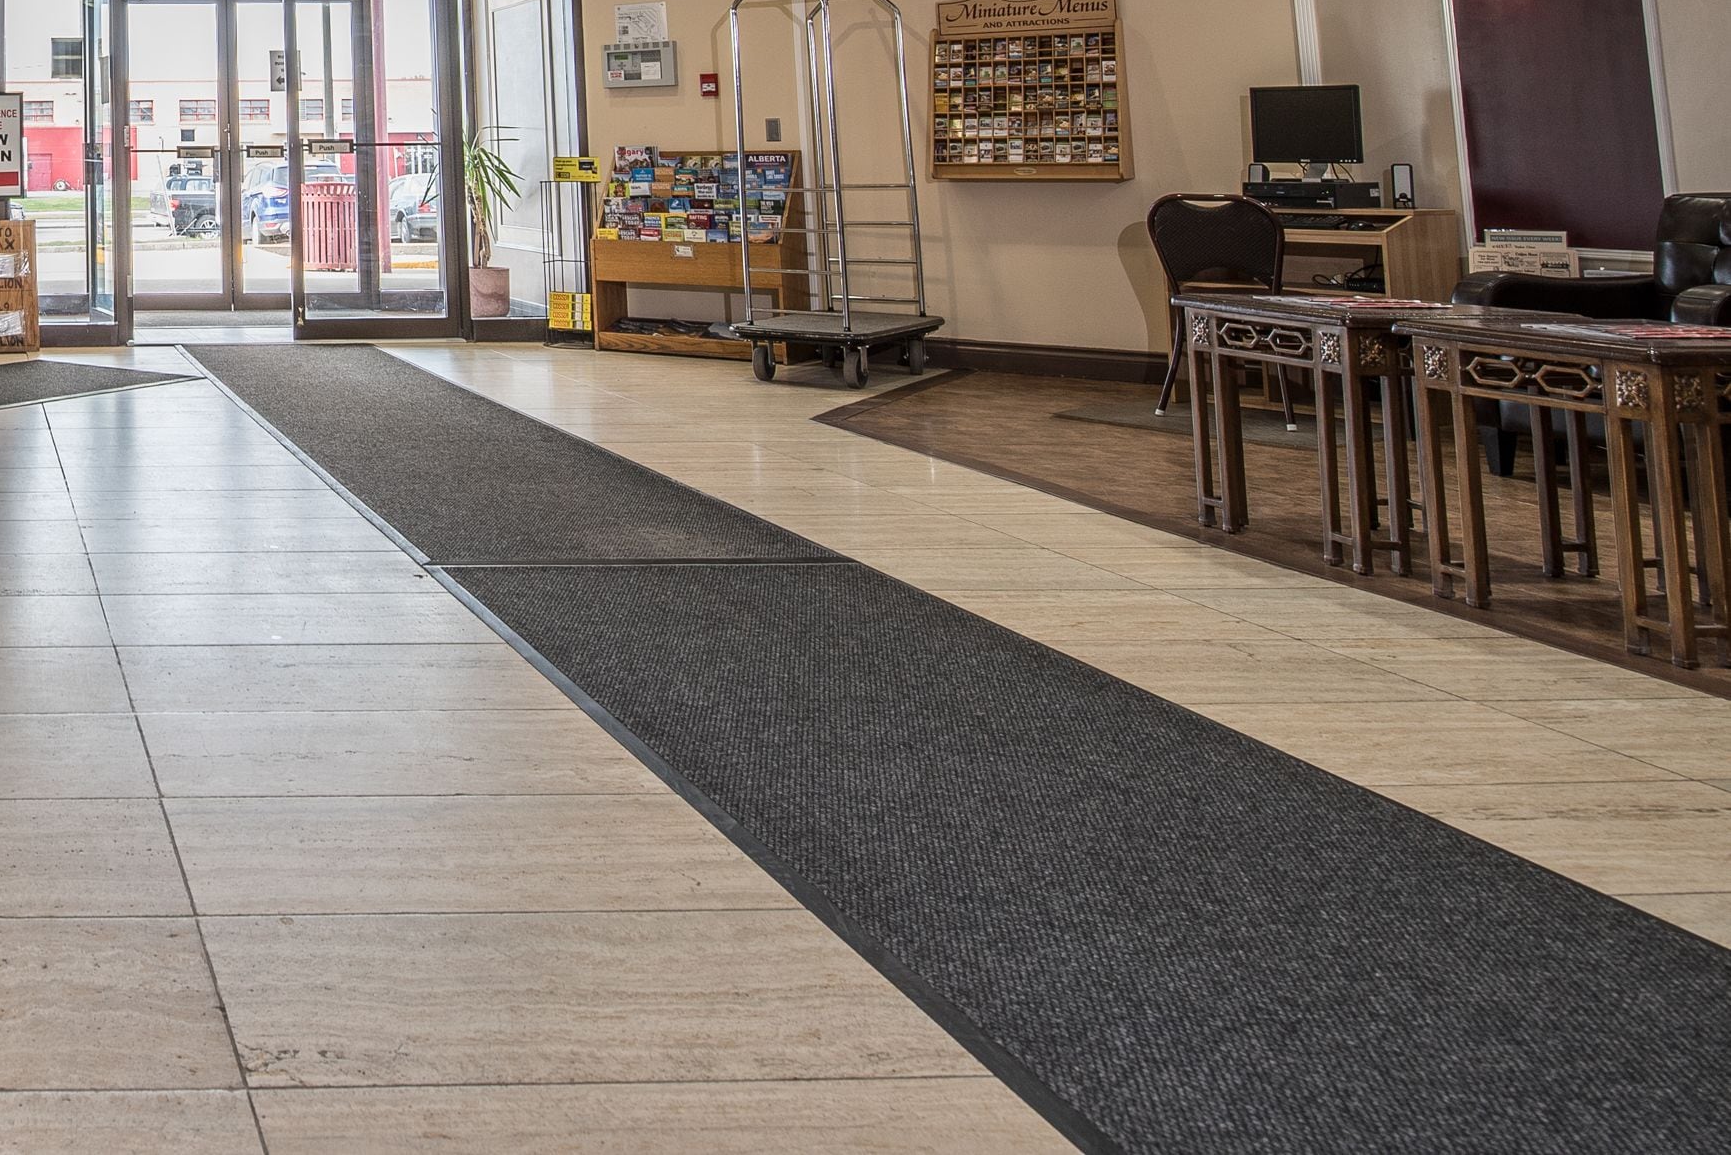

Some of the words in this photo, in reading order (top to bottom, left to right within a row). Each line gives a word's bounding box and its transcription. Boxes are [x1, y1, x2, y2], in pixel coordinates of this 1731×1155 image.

[945, 3, 1040, 22] Miniature
[982, 21, 1003, 29] AND
[1005, 17, 1070, 28] ATTRACTIONS
[319, 144, 335, 152] Push
